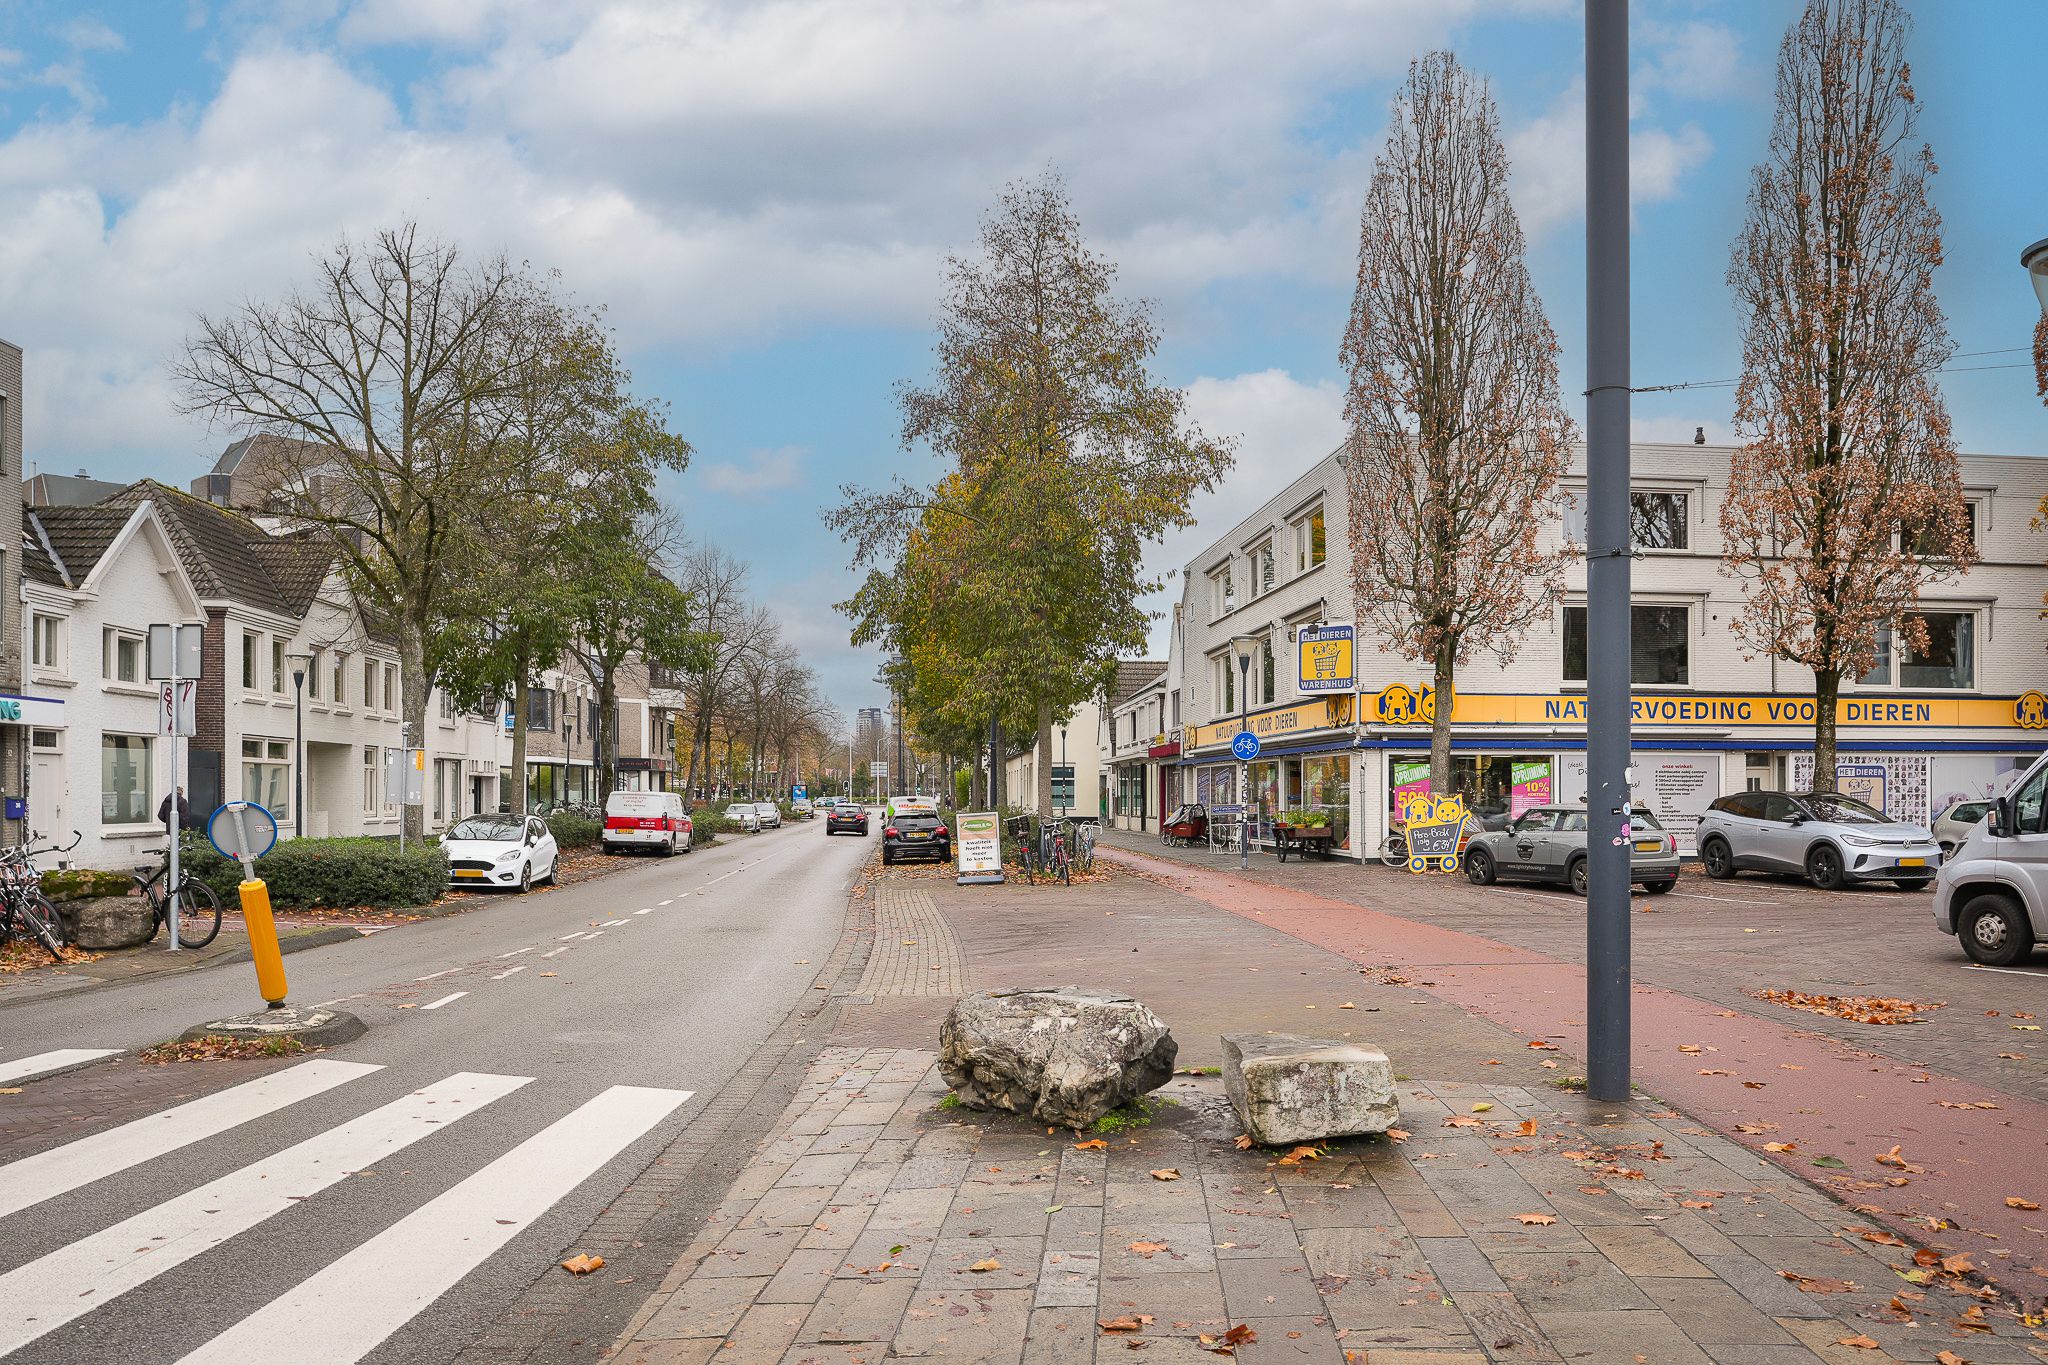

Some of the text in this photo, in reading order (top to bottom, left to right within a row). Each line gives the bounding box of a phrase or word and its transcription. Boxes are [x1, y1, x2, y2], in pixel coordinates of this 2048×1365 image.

[1321, 630, 1352, 640] DIEREN
[1301, 679, 1352, 690] WARENHUIS
[1545, 700, 1931, 721] NATRVOEDING VOO DIEREN
[1257, 716, 1273, 733] VOOR
[1276, 711, 1298, 730] DIEREN
[1512, 763, 1548, 785] OPRUIMING
[1856, 768, 1884, 776] DIEREN
[1525, 781, 1550, 792] 10%
